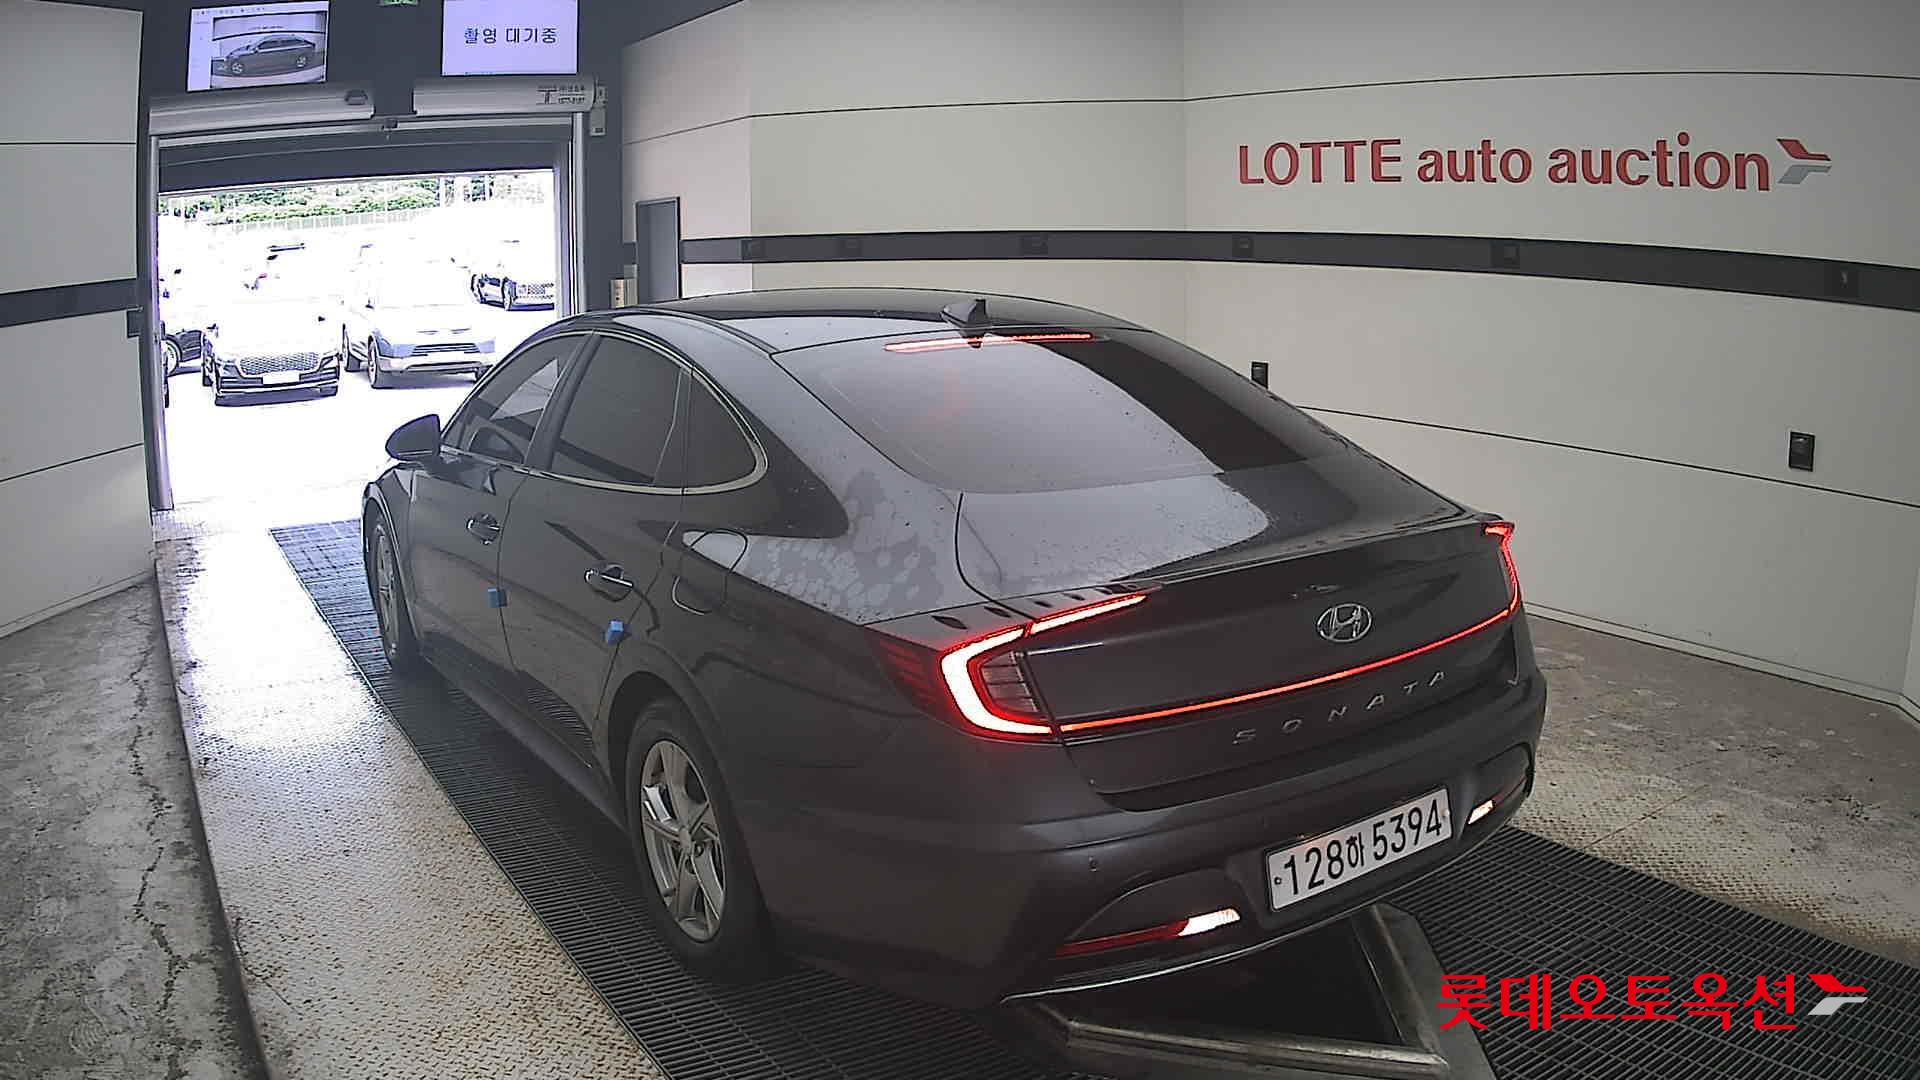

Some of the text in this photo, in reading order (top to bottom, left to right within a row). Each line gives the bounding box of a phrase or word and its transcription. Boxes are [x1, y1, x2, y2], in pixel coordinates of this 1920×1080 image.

[464, 27, 558, 44] 촬영 대기중
[1239, 131, 1770, 191] LOTTE auto auction
[1232, 671, 1445, 744] SONATA
[1284, 799, 1442, 895] 128하 5394
